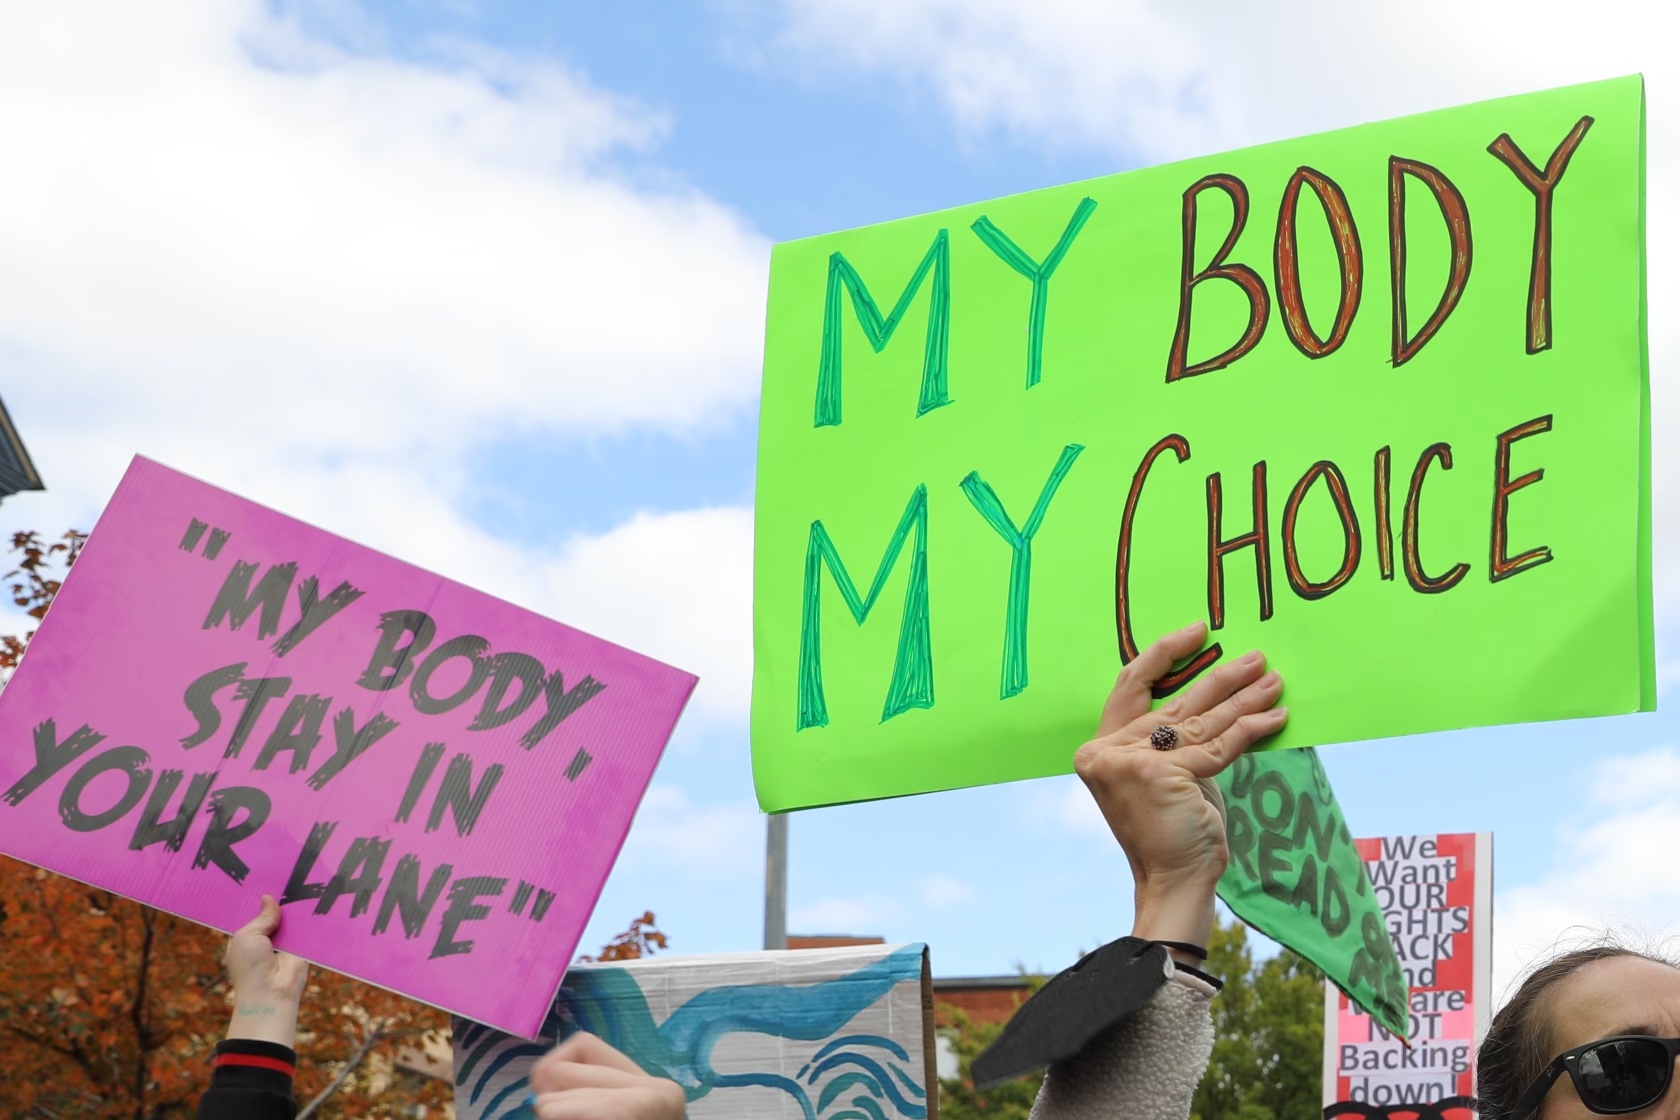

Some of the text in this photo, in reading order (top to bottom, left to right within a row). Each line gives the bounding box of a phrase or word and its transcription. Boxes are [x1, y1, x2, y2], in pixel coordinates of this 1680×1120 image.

[813, 115, 1595, 429] MY BODY
[796, 414, 1554, 733] MY CHOICE
[179, 662, 504, 836] STAY IN
[1, 717, 271, 886] YOUR
[1382, 835, 1437, 861] We
[1226, 806, 1350, 938] READ
[1366, 859, 1456, 886] Want
[1373, 884, 1446, 911] OUR
[1383, 907, 1468, 936] GHTS
[1391, 932, 1452, 961] ACK
[1403, 960, 1436, 988] nd
[1411, 990, 1465, 1013] are
[1340, 1041, 1469, 1074] Backing
[1351, 1074, 1458, 1105] down!
